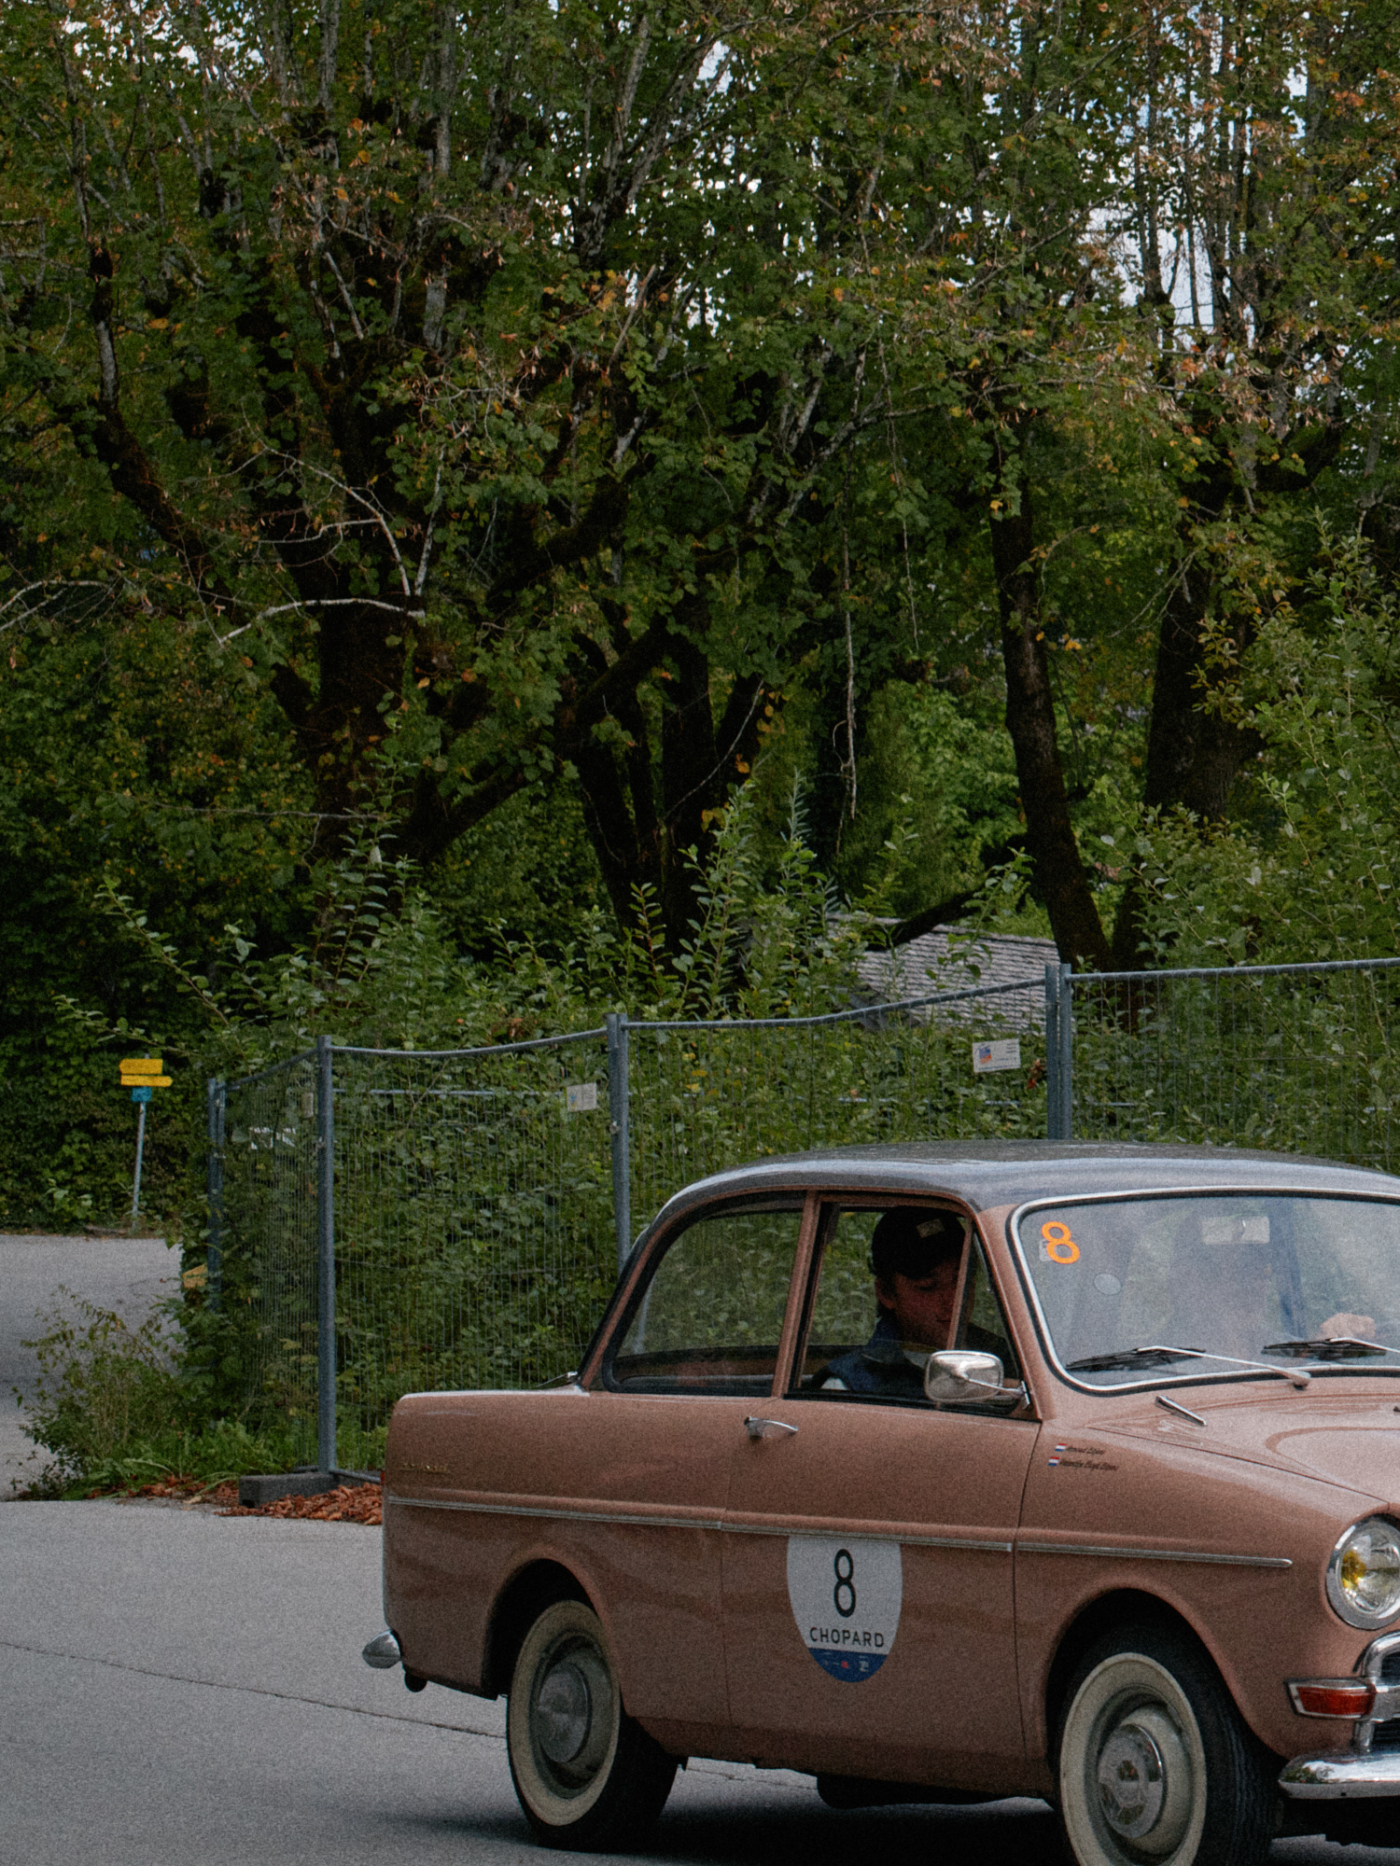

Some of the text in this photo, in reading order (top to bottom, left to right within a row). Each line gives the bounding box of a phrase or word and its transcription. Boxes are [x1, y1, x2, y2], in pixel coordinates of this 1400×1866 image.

[1041, 1221, 1080, 1265] 8
[834, 1548, 856, 1618] 8
[809, 1627, 885, 1648] CHOPARD
